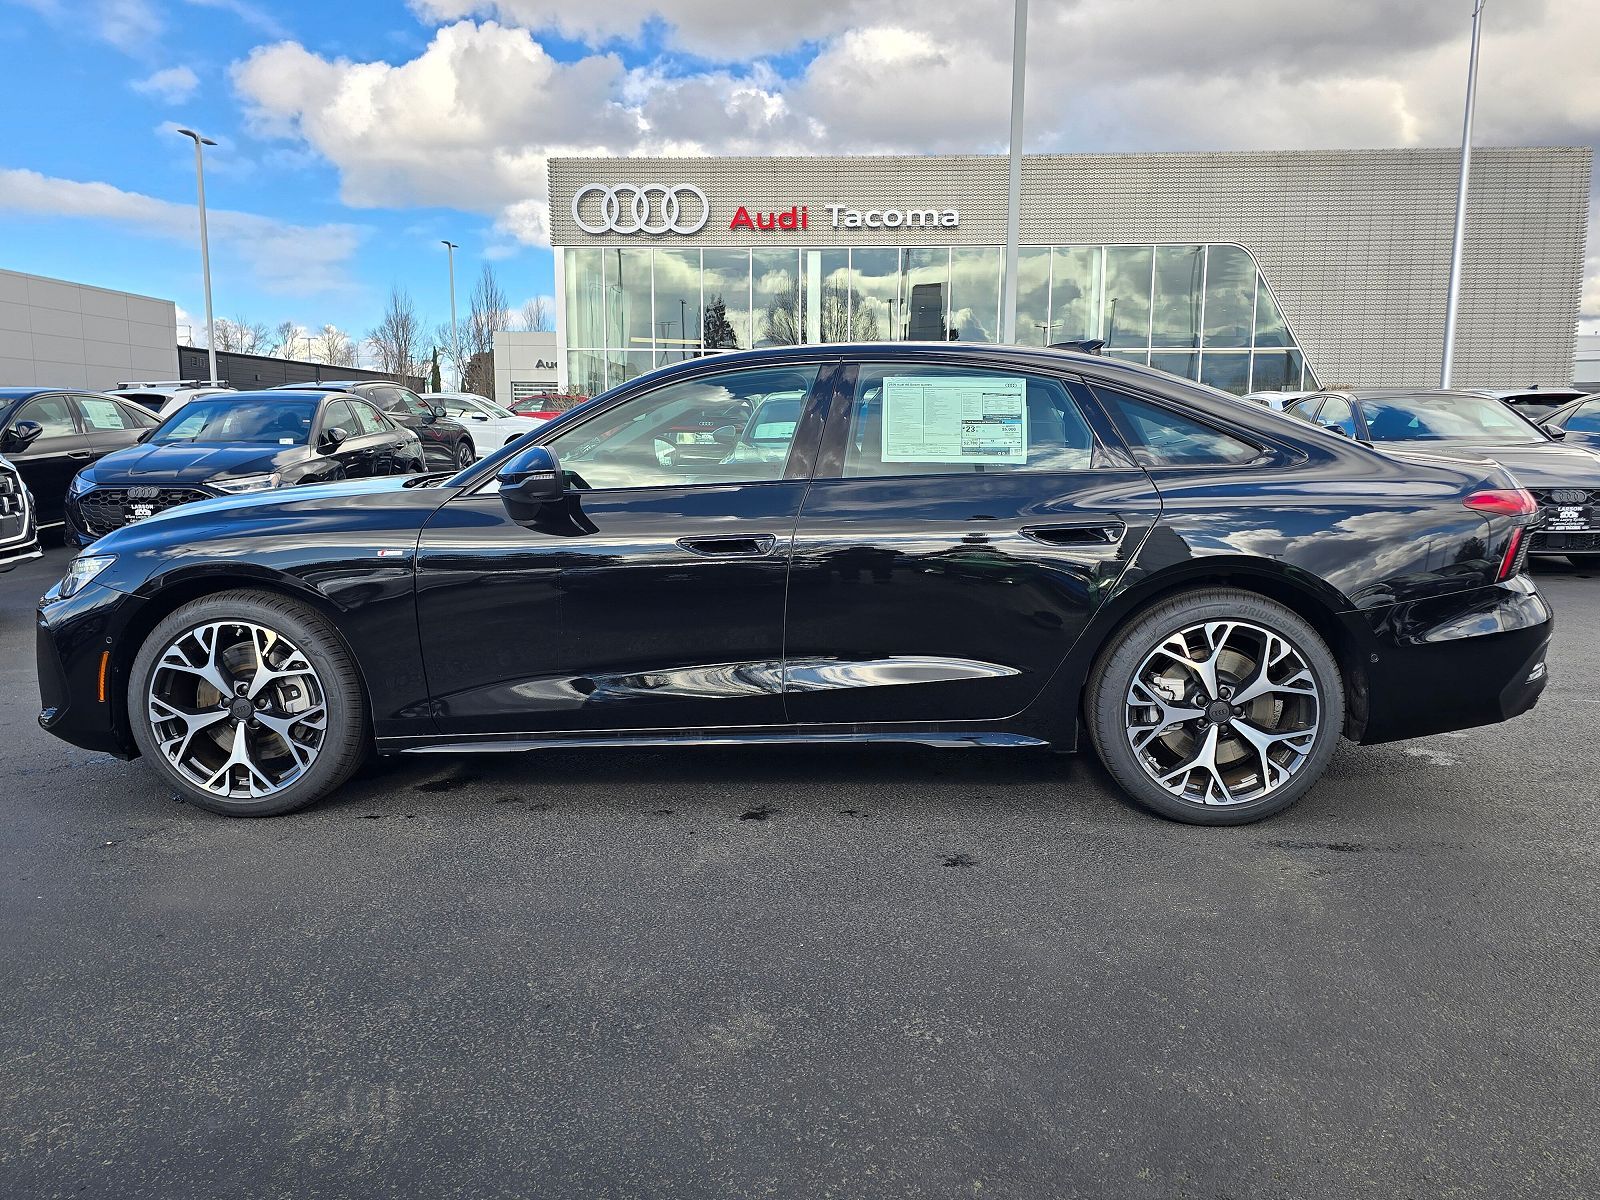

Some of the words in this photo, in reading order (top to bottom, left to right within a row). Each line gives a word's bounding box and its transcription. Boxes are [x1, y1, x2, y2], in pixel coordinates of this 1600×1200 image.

[730, 205, 808, 230] Audi
[825, 204, 960, 228] Tacoma
[965, 425, 976, 433] 23
[1236, 604, 1311, 647] BRIDGESTONE
